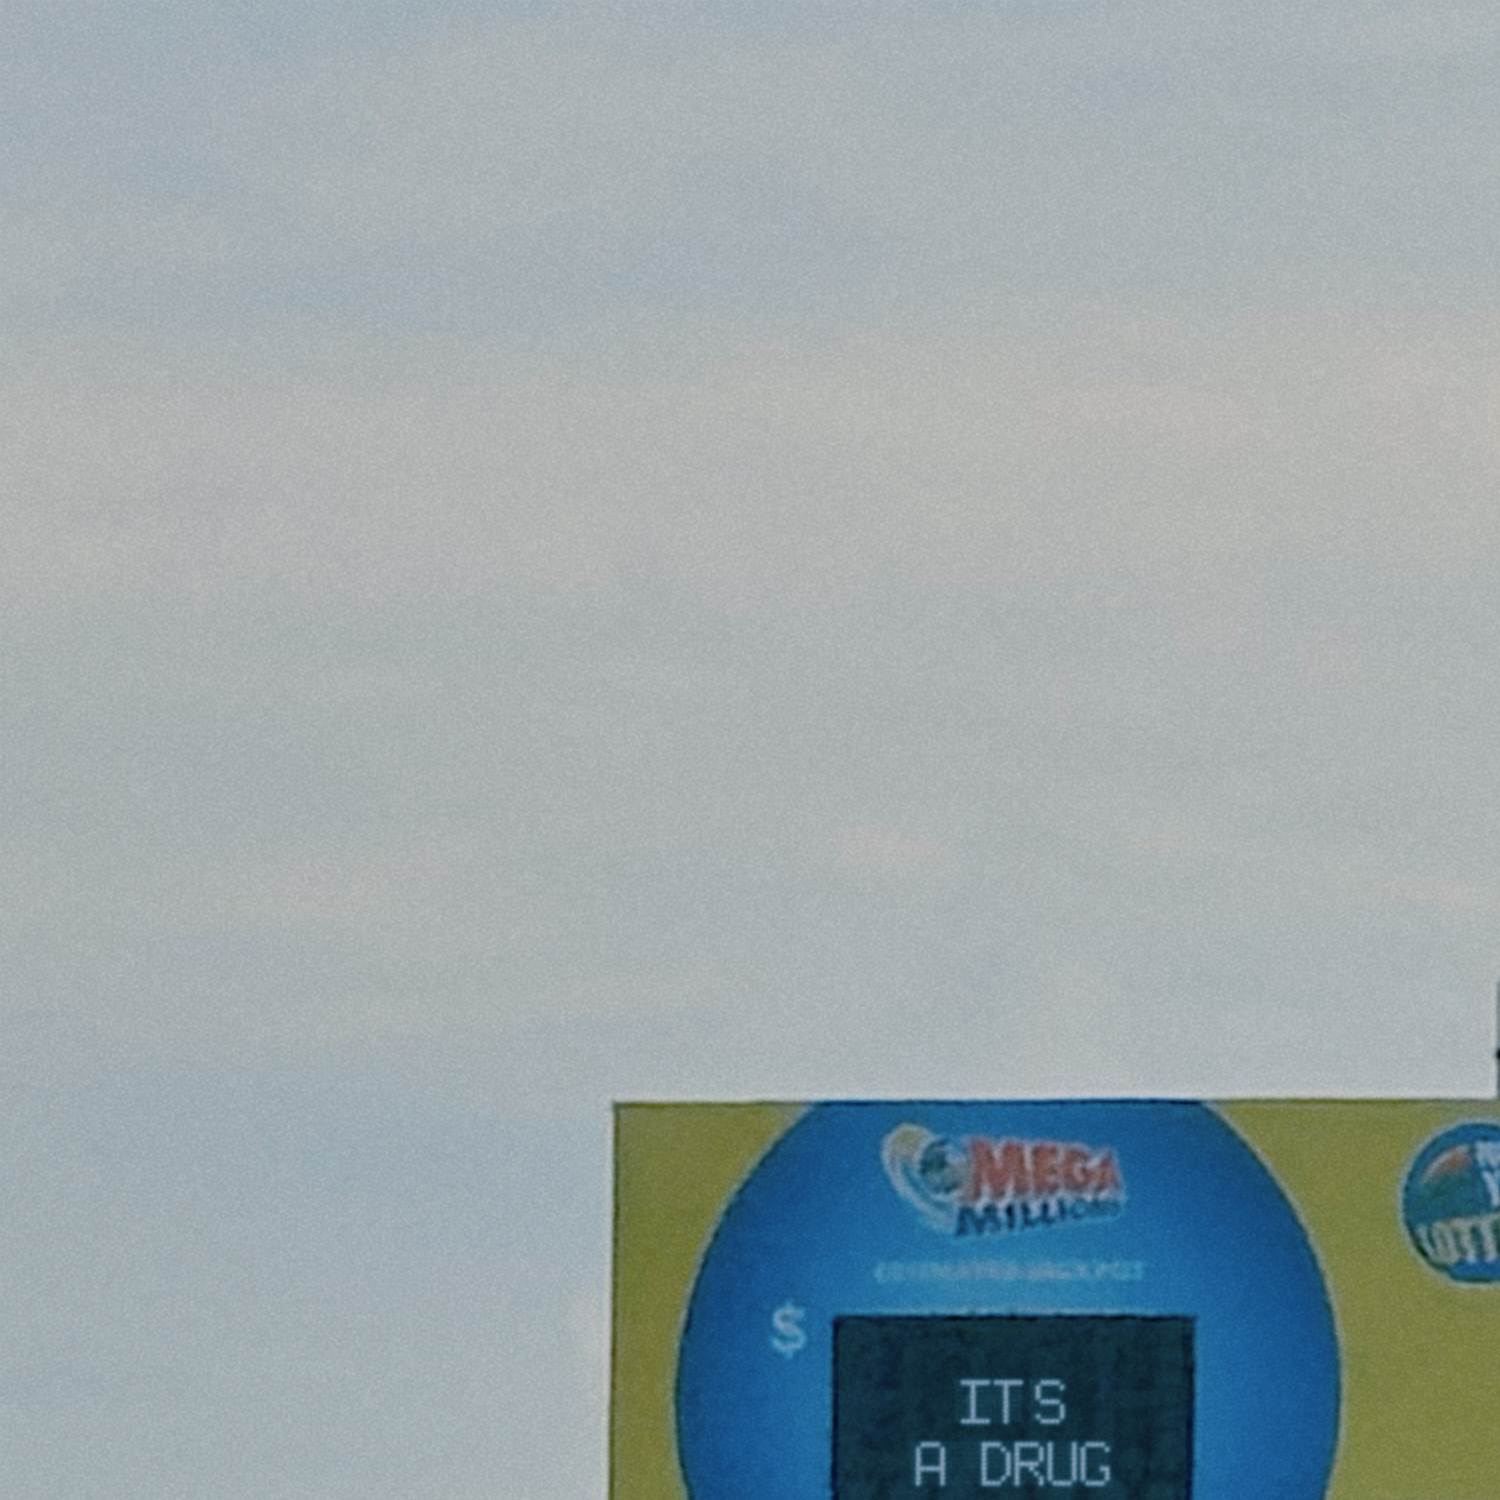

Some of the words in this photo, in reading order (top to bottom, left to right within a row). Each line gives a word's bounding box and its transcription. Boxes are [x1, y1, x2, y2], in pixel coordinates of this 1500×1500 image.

[965, 1137, 1122, 1201] MEGA
[955, 1197, 1122, 1238] MILLI
[770, 1301, 807, 1359] $
[914, 1442, 945, 1487] A
[980, 1442, 1111, 1487] DRUG
